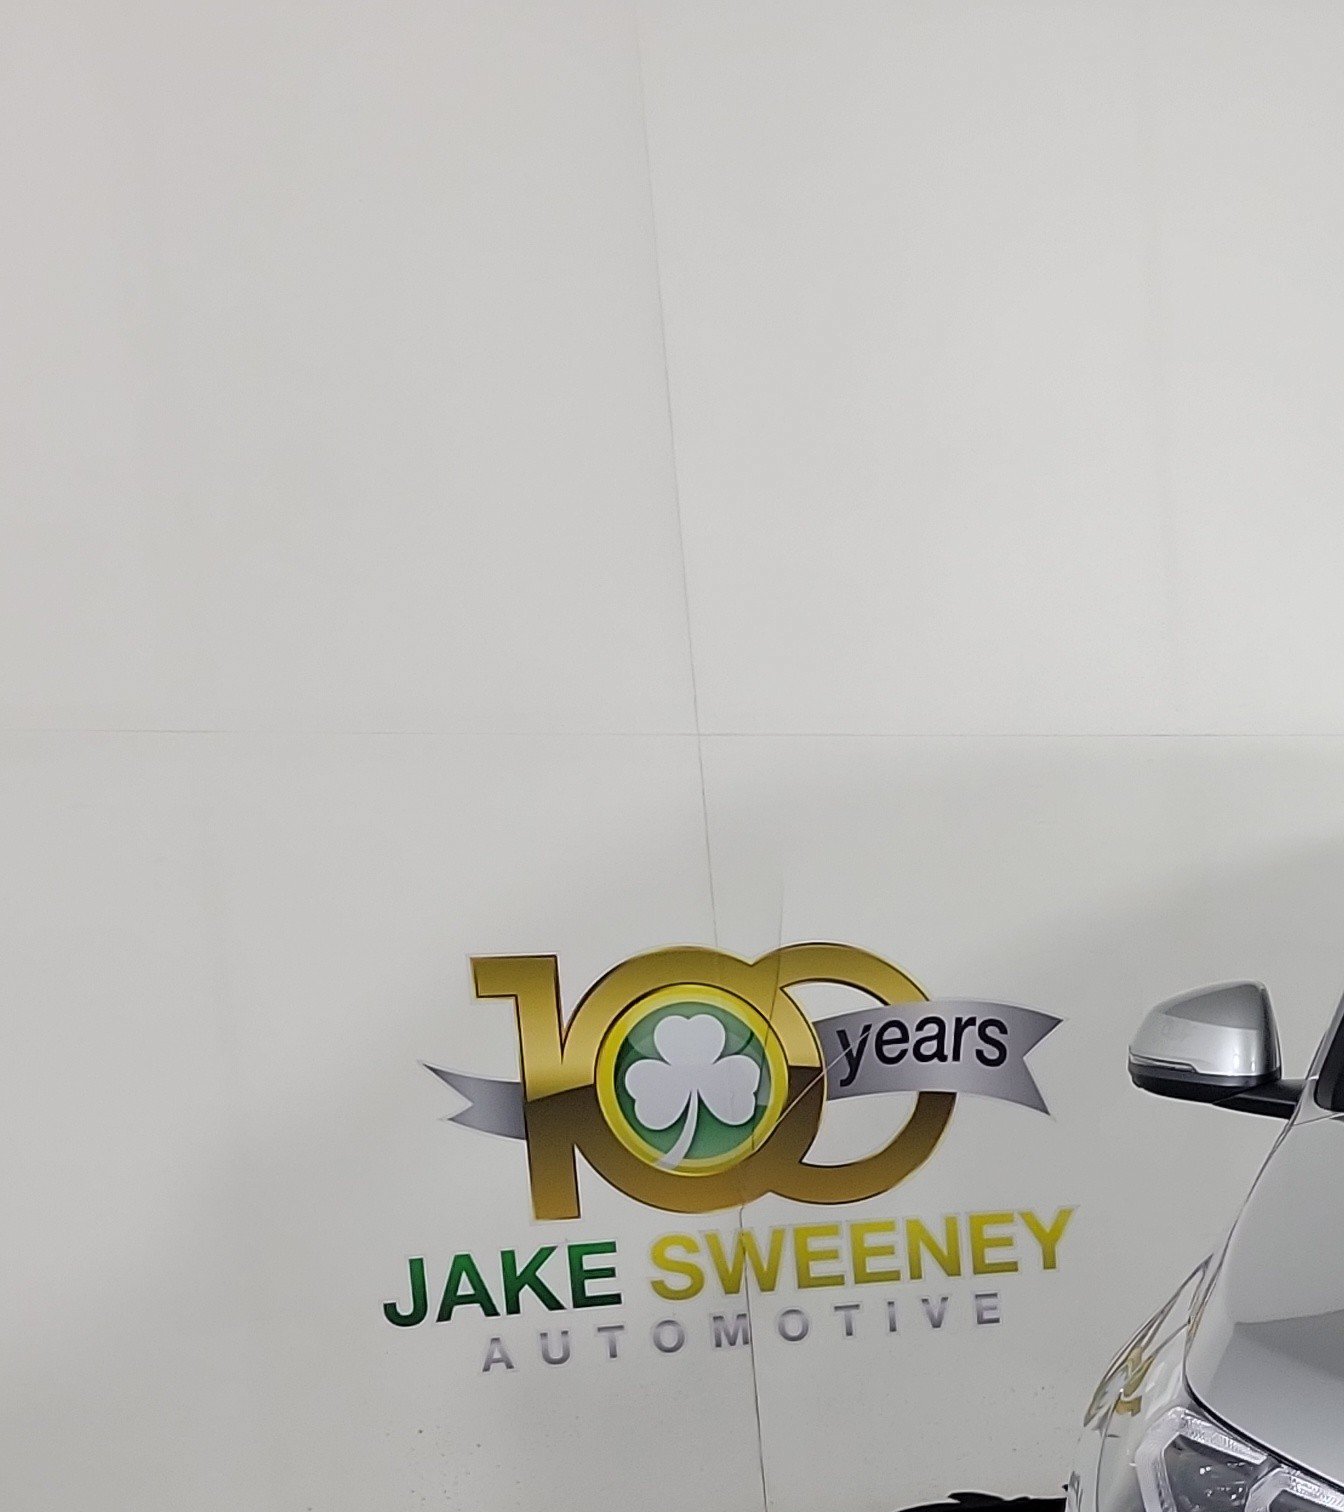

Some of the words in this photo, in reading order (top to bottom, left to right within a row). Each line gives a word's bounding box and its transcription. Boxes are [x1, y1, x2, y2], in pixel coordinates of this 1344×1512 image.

[837, 1011, 1007, 1086] years
[384, 1240, 621, 1328] JAKE
[650, 1208, 1073, 1301] SWEENEY
[482, 1292, 1001, 1373] AUTOMOTIVE
